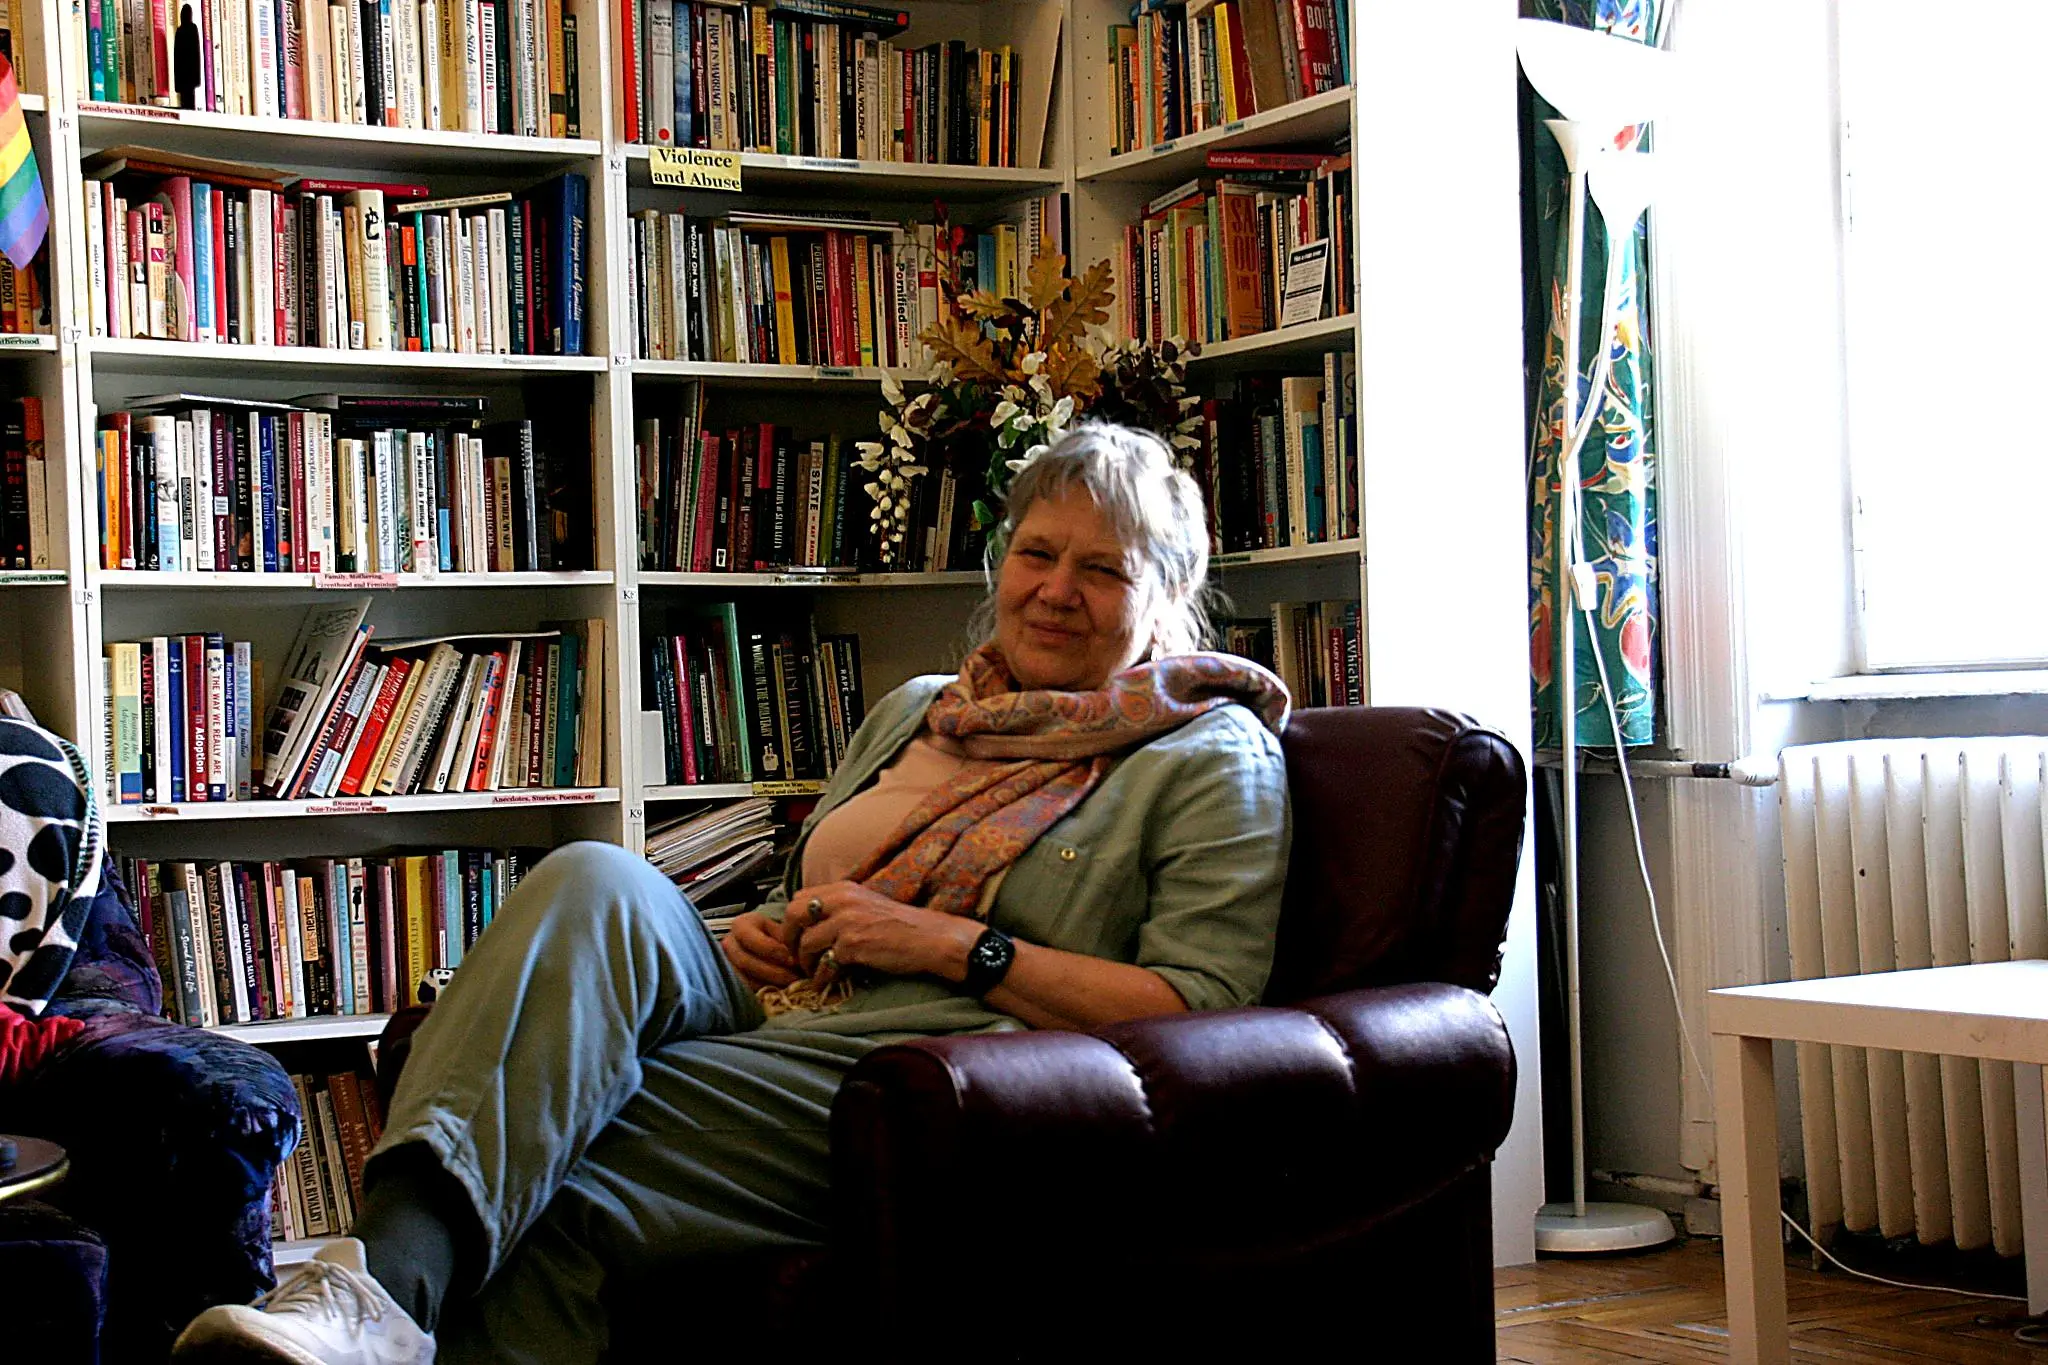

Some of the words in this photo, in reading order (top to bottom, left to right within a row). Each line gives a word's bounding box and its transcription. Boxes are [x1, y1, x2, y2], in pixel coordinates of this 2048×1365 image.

[708, 24, 719, 48] RAPE
[711, 49, 720, 60] IN
[712, 62, 722, 108] MARRIAGE
[857, 60, 865, 94] SEXUAL
[858, 97, 866, 141] VIOLENCE
[657, 148, 733, 168] Violence
[1233, 157, 1255, 165] Collins
[654, 170, 685, 185] and
[690, 172, 741, 190] Abuse
[512, 216, 522, 238] MYTH
[571, 216, 583, 261] Marriages
[690, 225, 698, 259] WOMEN
[1153, 234, 1160, 250] no
[514, 255, 523, 271] BAD
[574, 263, 582, 280] and
[692, 261, 699, 275] ON
[813, 246, 824, 291] PORNIFIED
[692, 278, 700, 298] WAR
[1153, 251, 1161, 302] excuses
[514, 273, 525, 305] MOTHER
[896, 263, 908, 323] Pornified
[572, 282, 583, 321] Families
[215, 428, 224, 463] MATERNAL
[236, 427, 245, 441] AT
[237, 443, 246, 462] THE
[307, 427, 317, 487] misconceptions
[378, 453, 387, 466] OF
[261, 449, 272, 481] Women
[183, 478, 192, 500] BLOOD
[217, 464, 225, 494] THINKING
[238, 468, 248, 506] BREAST
[262, 482, 272, 491] &
[810, 470, 821, 511] STATE
[184, 500, 193, 508] AT
[379, 472, 389, 512] WOMAN
[184, 508, 193, 521] THE
[263, 491, 273, 530] Families
[184, 521, 194, 538] ROOT
[381, 515, 390, 546] BORN
[752, 644, 764, 675] WOMEN
[1332, 637, 1340, 661] MARY
[536, 666, 543, 676] MY
[1333, 662, 1341, 682] DALY
[1346, 639, 1358, 684] Which
[211, 676, 220, 691] THE
[225, 662, 234, 700] Remaking
[754, 676, 765, 686] IN
[839, 669, 850, 693] RAPE
[104, 696, 113, 708] THE
[212, 693, 220, 711] WAY
[416, 693, 427, 707] THE
[534, 697, 542, 716] RIDES
[756, 688, 768, 701] THE
[213, 714, 220, 727] WE
[226, 701, 235, 733] Families
[238, 706, 249, 726] NEW
[404, 709, 420, 735] OTHER
[758, 702, 774, 737] MILITARY
[104, 712, 114, 747] ADOPTION
[194, 727, 206, 774] Adoption
[213, 728, 221, 757] REALLY
[105, 749, 115, 784] TRIANGLE
[213, 760, 222, 775] ARE
[532, 755, 540, 768] BUS
[629, 808, 643, 818] K9
[206, 865, 219, 902] VENUS
[189, 895, 197, 906] my
[470, 890, 478, 902] the
[209, 902, 223, 937] AFTER
[242, 923, 251, 938] OUR
[410, 917, 418, 944] BETTY
[213, 937, 228, 971] FORTY
[244, 938, 253, 964] FUTURE
[247, 965, 257, 988] SELVES
[411, 947, 420, 986] FRIEDAN
[300, 1151, 316, 1186] SIBLING
[307, 1187, 323, 1223] RIVALRY
